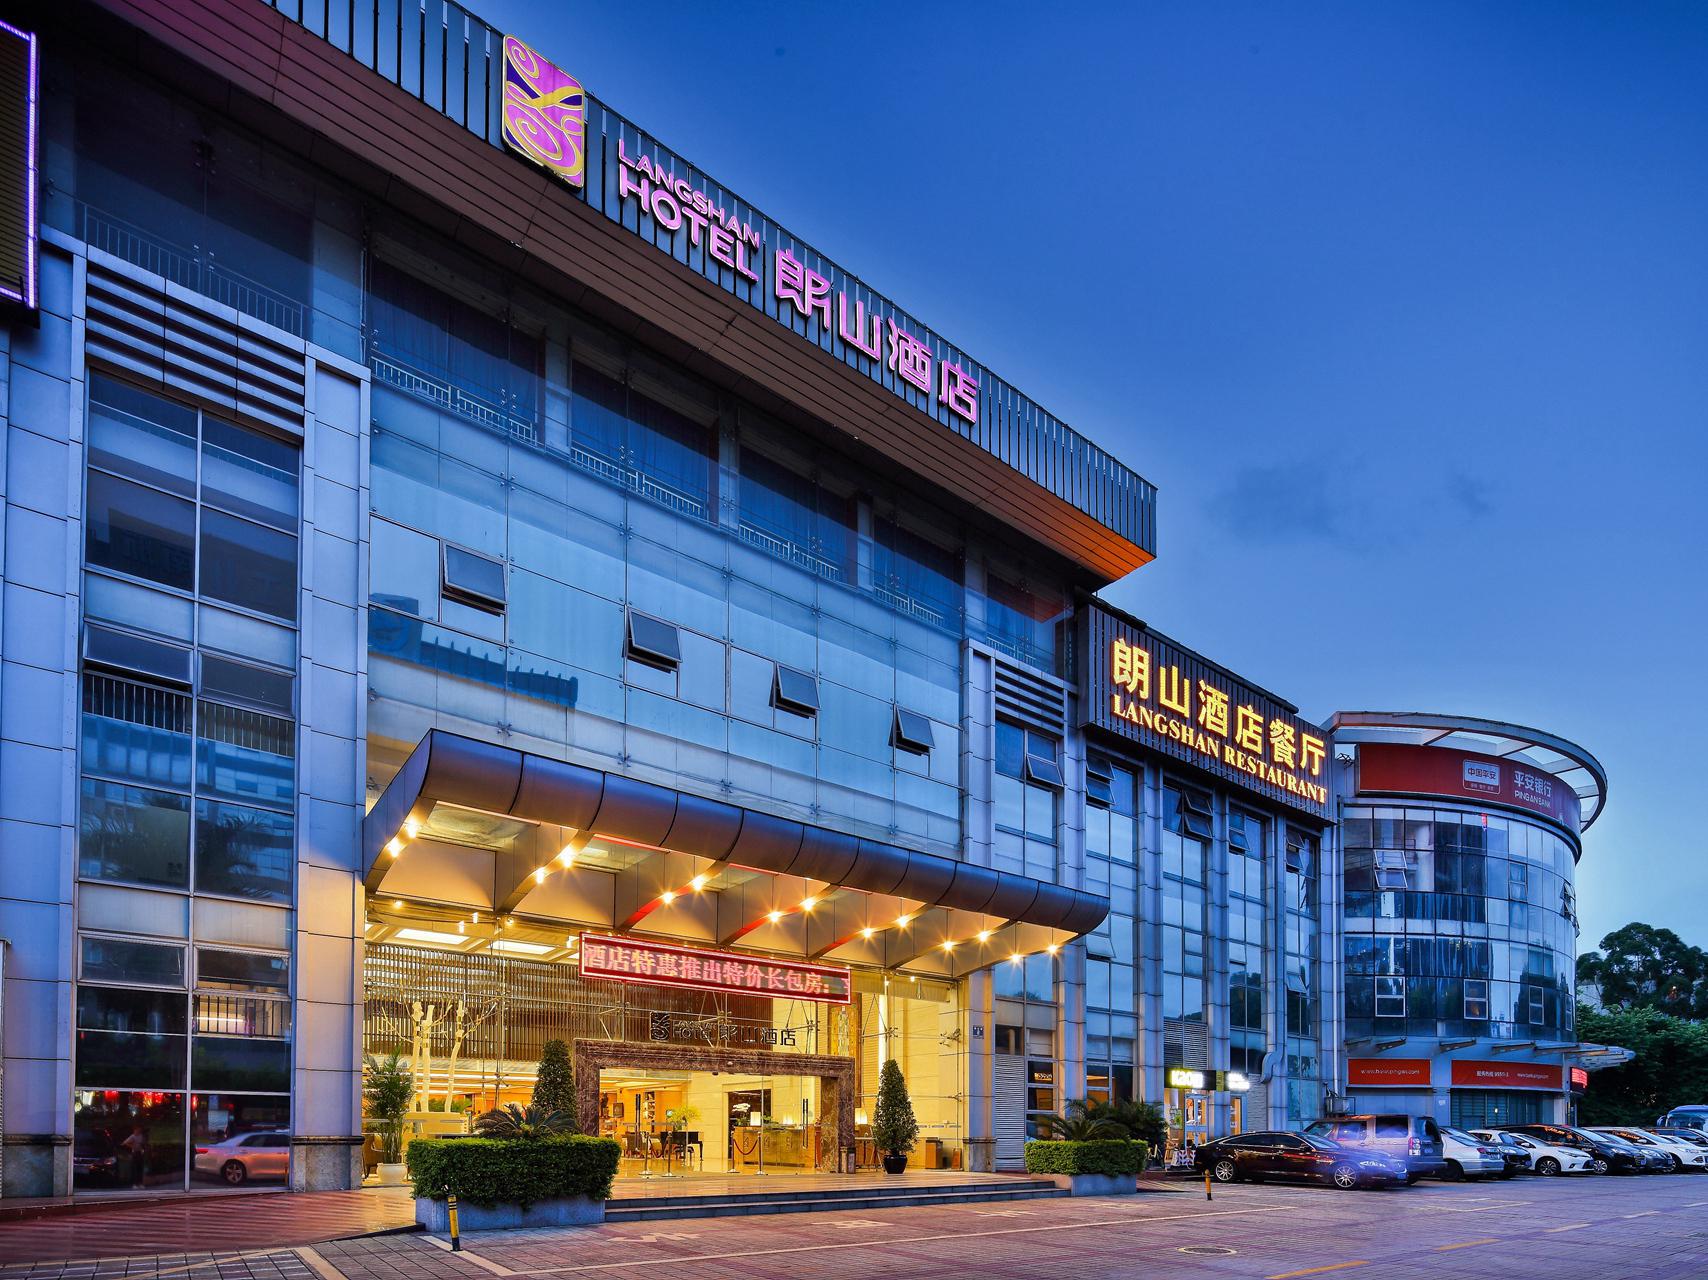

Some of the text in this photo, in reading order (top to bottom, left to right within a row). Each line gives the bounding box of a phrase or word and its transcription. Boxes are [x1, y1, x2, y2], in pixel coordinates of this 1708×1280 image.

[618, 139, 760, 251] LANGSHAN
[619, 163, 759, 283] HOTEL
[775, 249, 977, 425] 朗山酒店
[1112, 638, 1326, 776] 朗山酒店餐厅
[1113, 694, 1327, 804] LANGSHAN RESTAURANT
[1514, 770, 1552, 797] 平安银行
